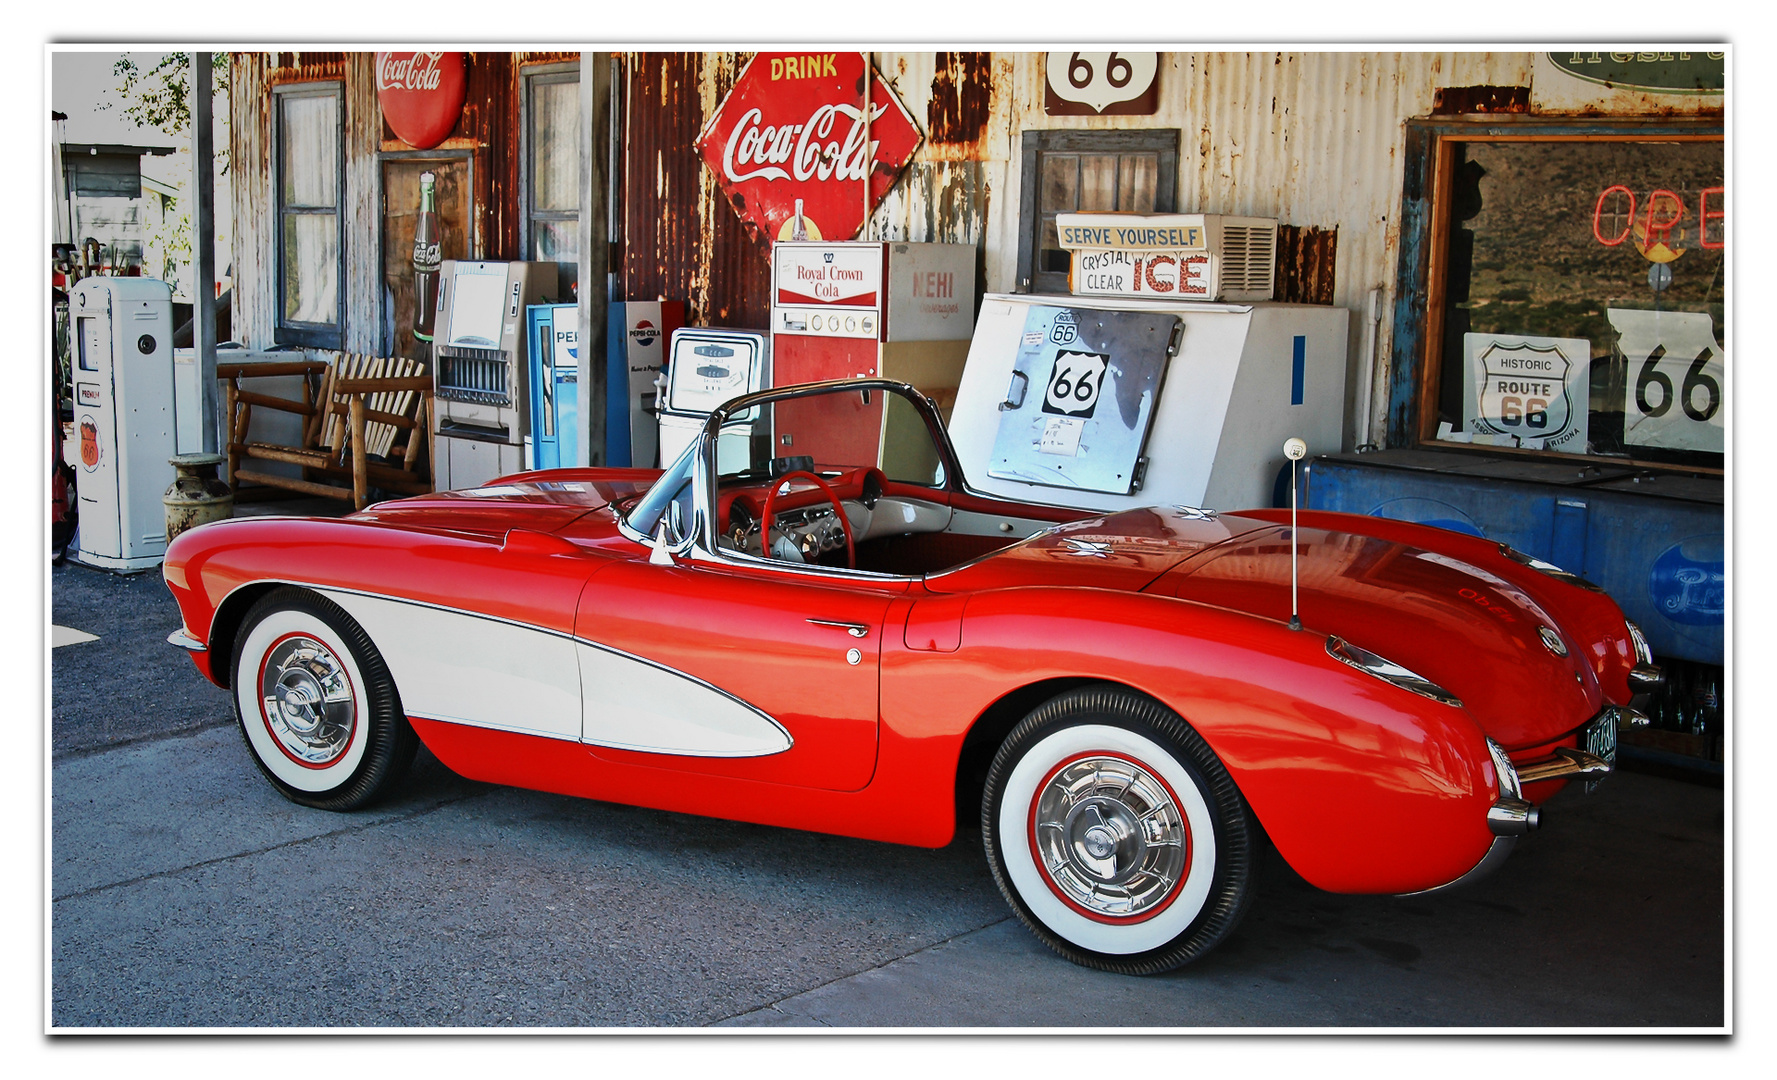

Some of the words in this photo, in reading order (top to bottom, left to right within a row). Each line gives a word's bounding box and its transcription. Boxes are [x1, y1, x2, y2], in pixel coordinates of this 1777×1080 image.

[770, 53, 838, 81] DRINK
[1068, 52, 1133, 89] 66
[723, 103, 889, 183] Coca-Cola
[1065, 228, 1112, 245] SERVE
[1117, 228, 1198, 246] YOURSELF
[1082, 250, 1131, 271] CRYSTAL
[797, 265, 826, 284] Royal
[830, 266, 863, 281] Crown
[1087, 274, 1123, 291] CLEAR
[1131, 252, 1209, 294] ICE
[814, 282, 839, 298] Cola
[913, 271, 954, 298] NEHI
[1053, 324, 1076, 342] 66
[1500, 358, 1552, 372] HISTORIC
[1053, 366, 1093, 402] 66
[1498, 381, 1551, 397] ROUTE
[1635, 343, 1720, 422] 66
[1501, 396, 1548, 429] 66
[83, 443, 95, 462] 66
